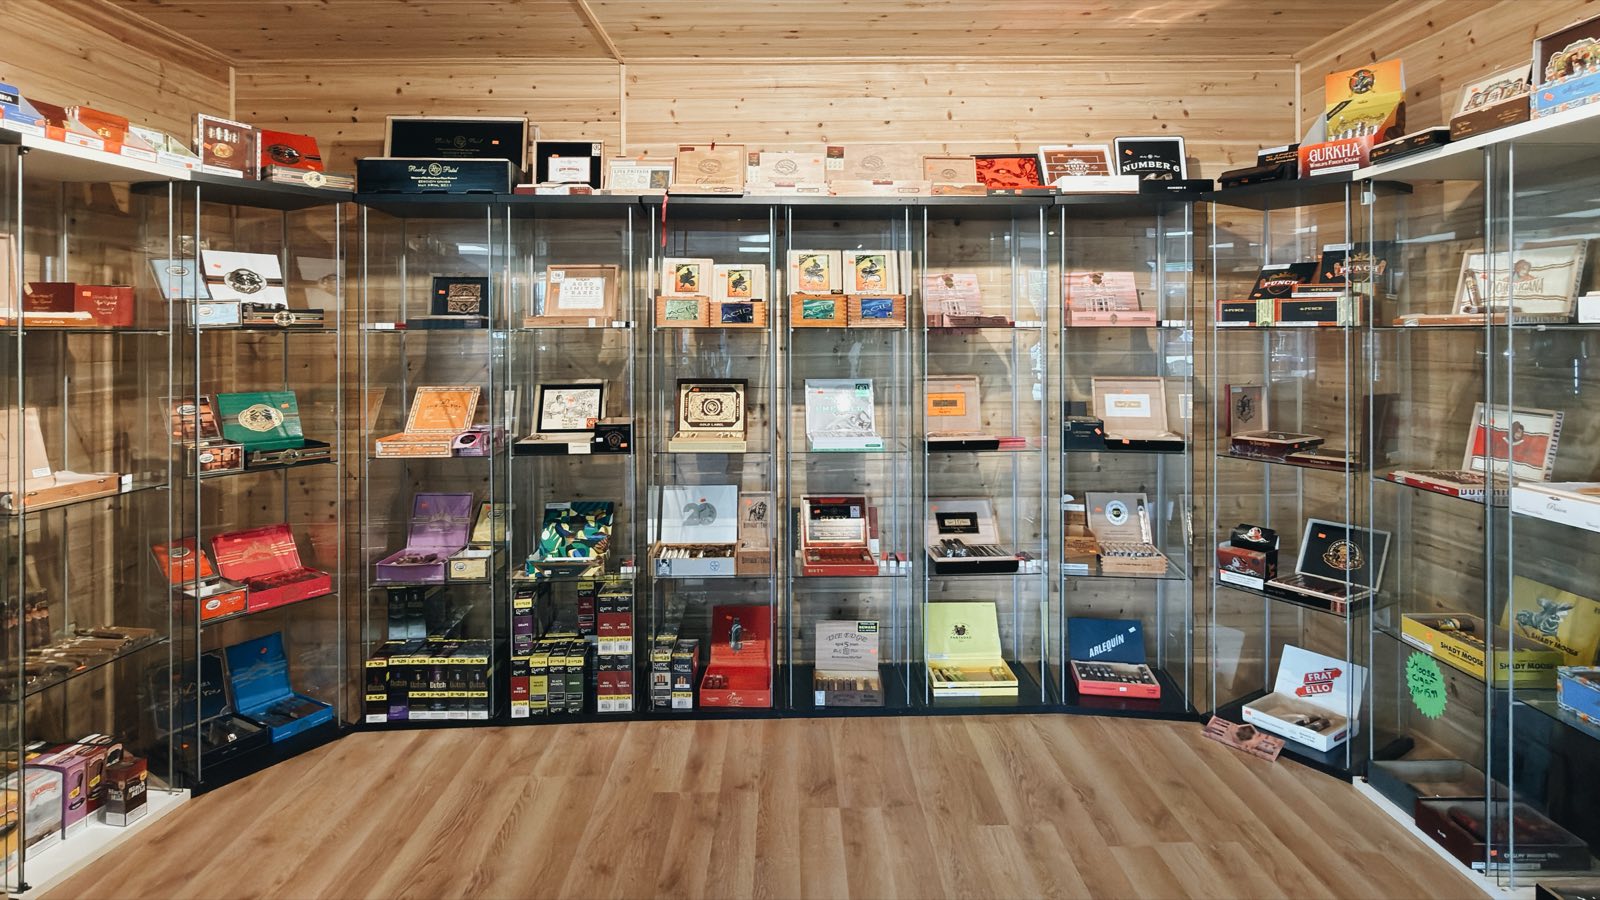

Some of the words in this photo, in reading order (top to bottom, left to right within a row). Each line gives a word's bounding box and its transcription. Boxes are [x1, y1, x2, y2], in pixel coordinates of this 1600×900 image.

[1308, 142, 1360, 162] GURKHA
[1122, 161, 1170, 172] NUMBER
[1173, 164, 1180, 172] 6
[668, 304, 697, 315] ACID
[722, 307, 751, 320] ACID
[804, 304, 833, 316] ACID
[862, 303, 892, 315] ACID
[682, 502, 717, 526] 20
[1089, 634, 1124, 658] ARLEQUÍN
[1532, 632, 1553, 646] SHADY
[1555, 642, 1578, 656] MOOSE
[1440, 642, 1462, 656] SHADY
[1462, 652, 1484, 666] MOOSE
[1308, 672, 1332, 681] FRAT
[1305, 684, 1330, 694] ELLO
